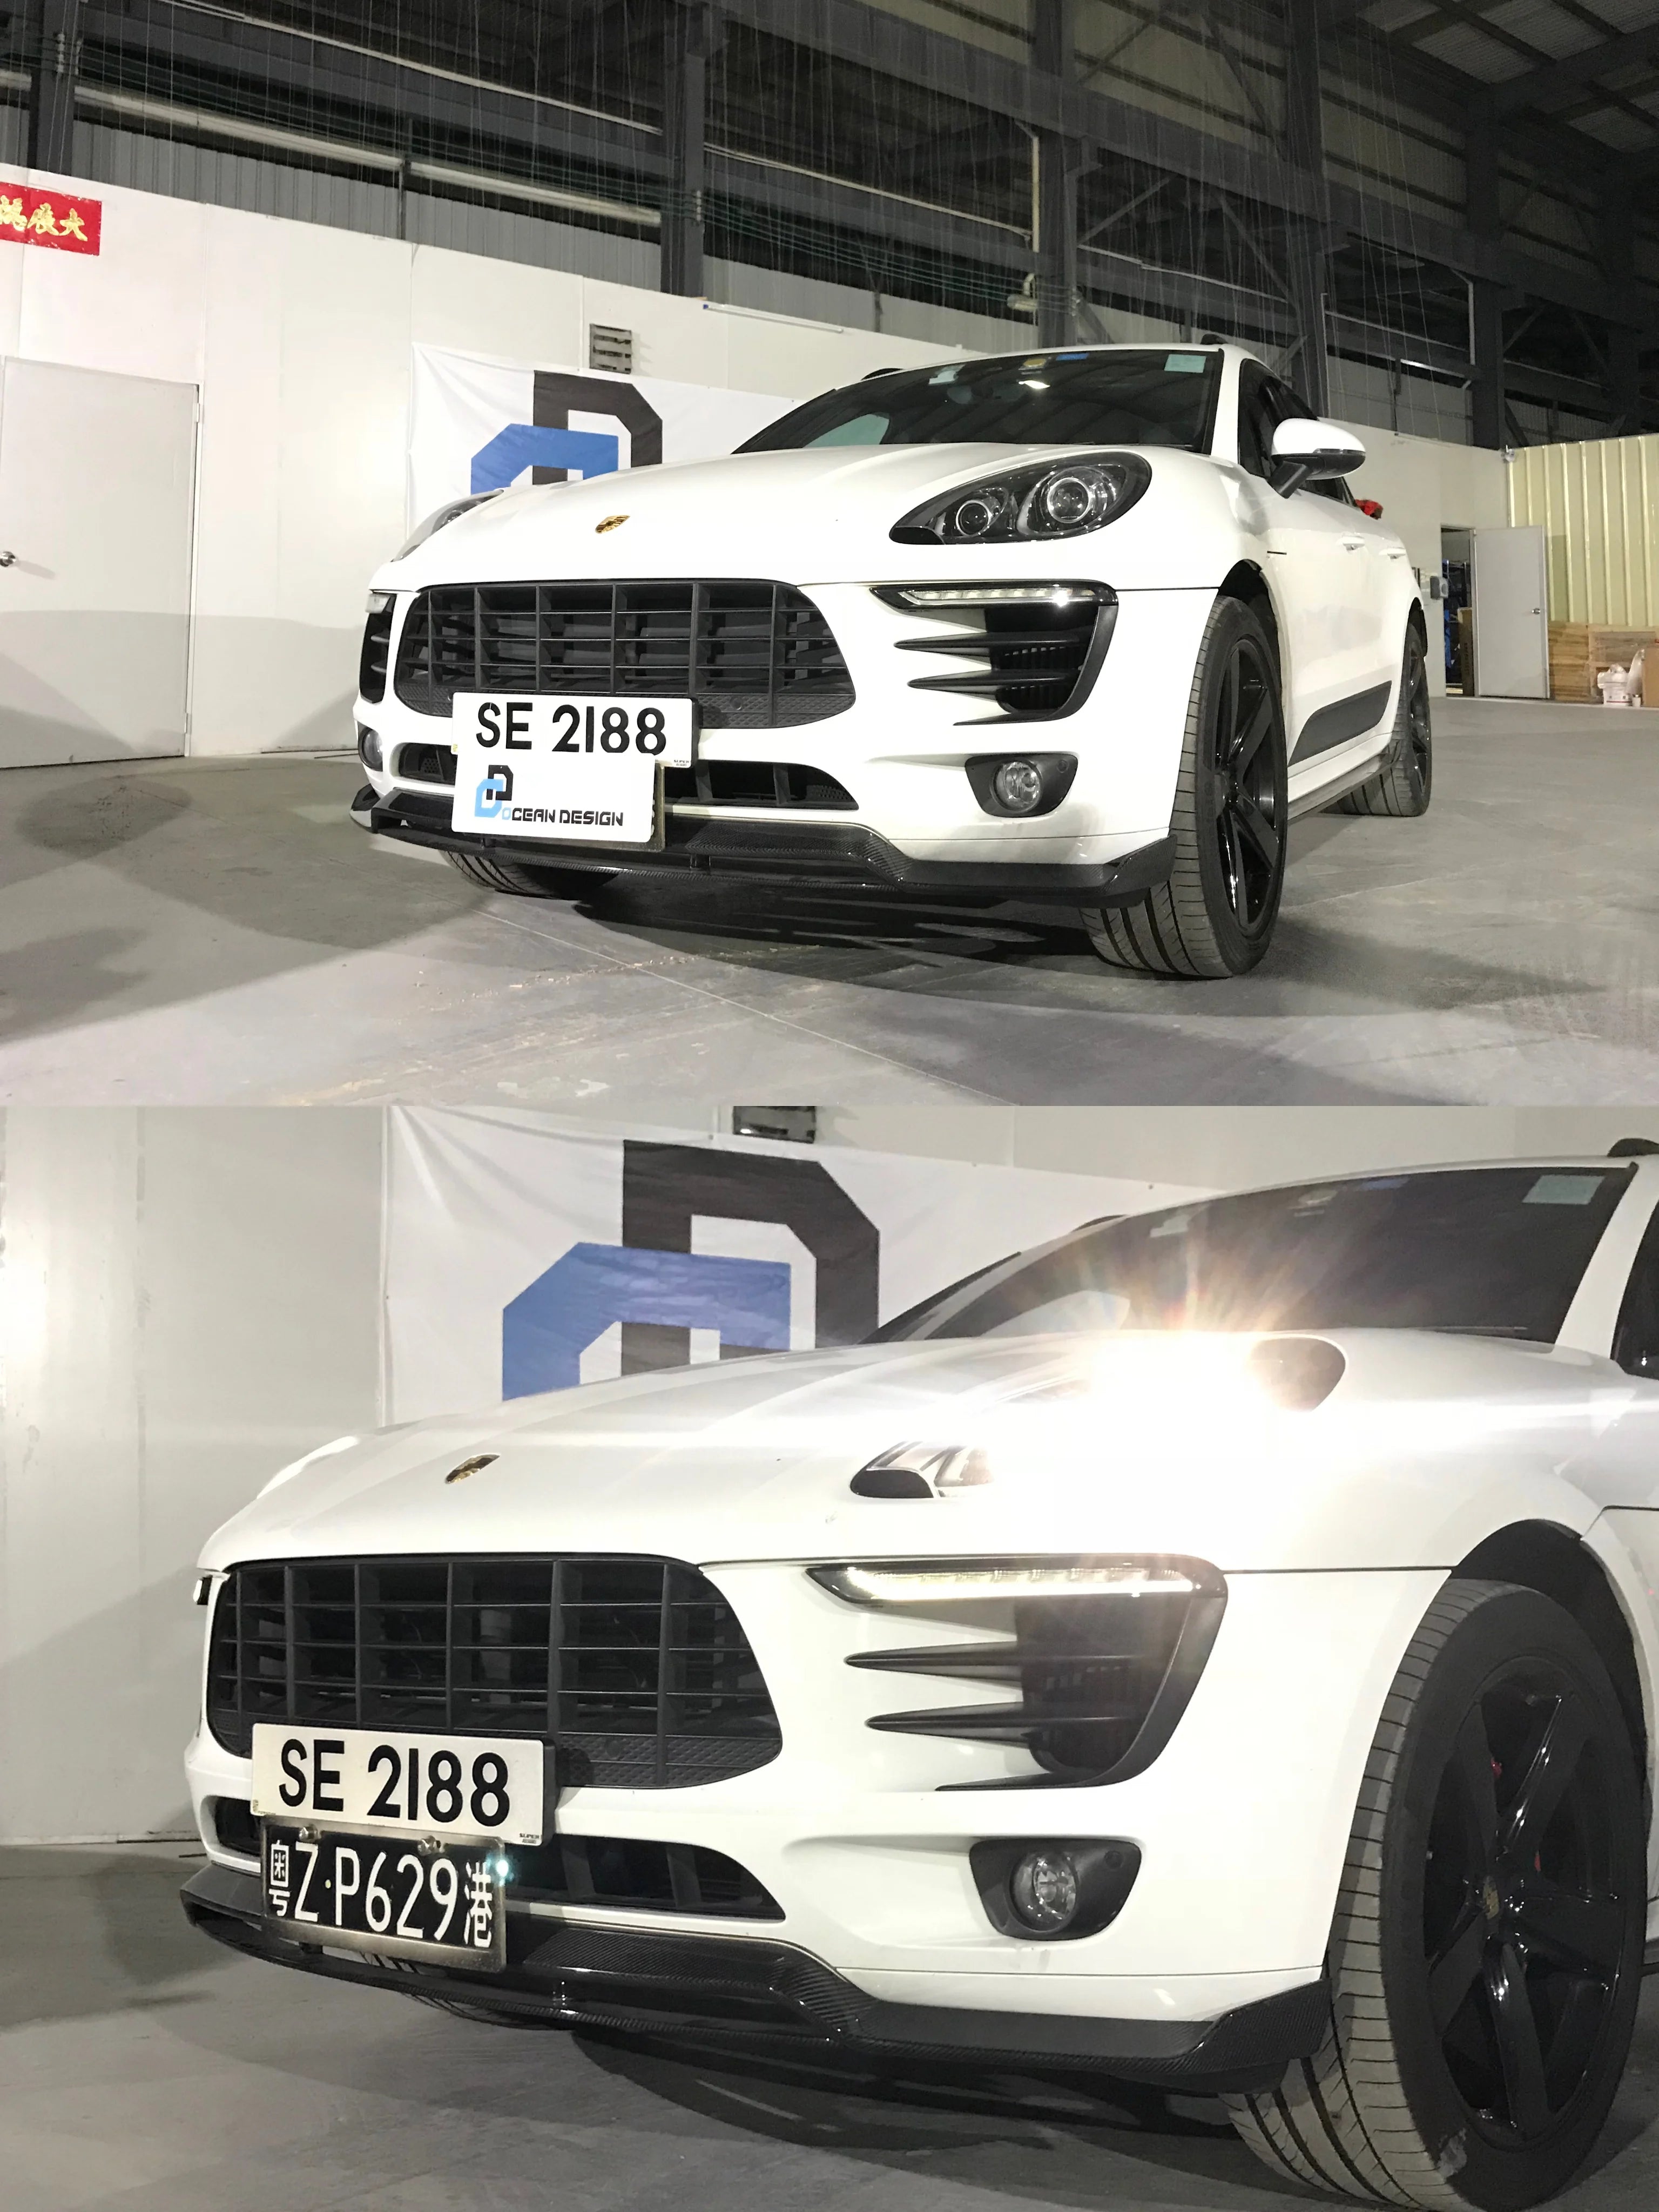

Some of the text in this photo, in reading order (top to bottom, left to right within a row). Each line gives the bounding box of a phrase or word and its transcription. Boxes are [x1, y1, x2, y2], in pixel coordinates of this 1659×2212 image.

[476, 702, 666, 756] SE 2188
[559, 810, 624, 826] DESIGN
[279, 1738, 510, 1826] SE 2188
